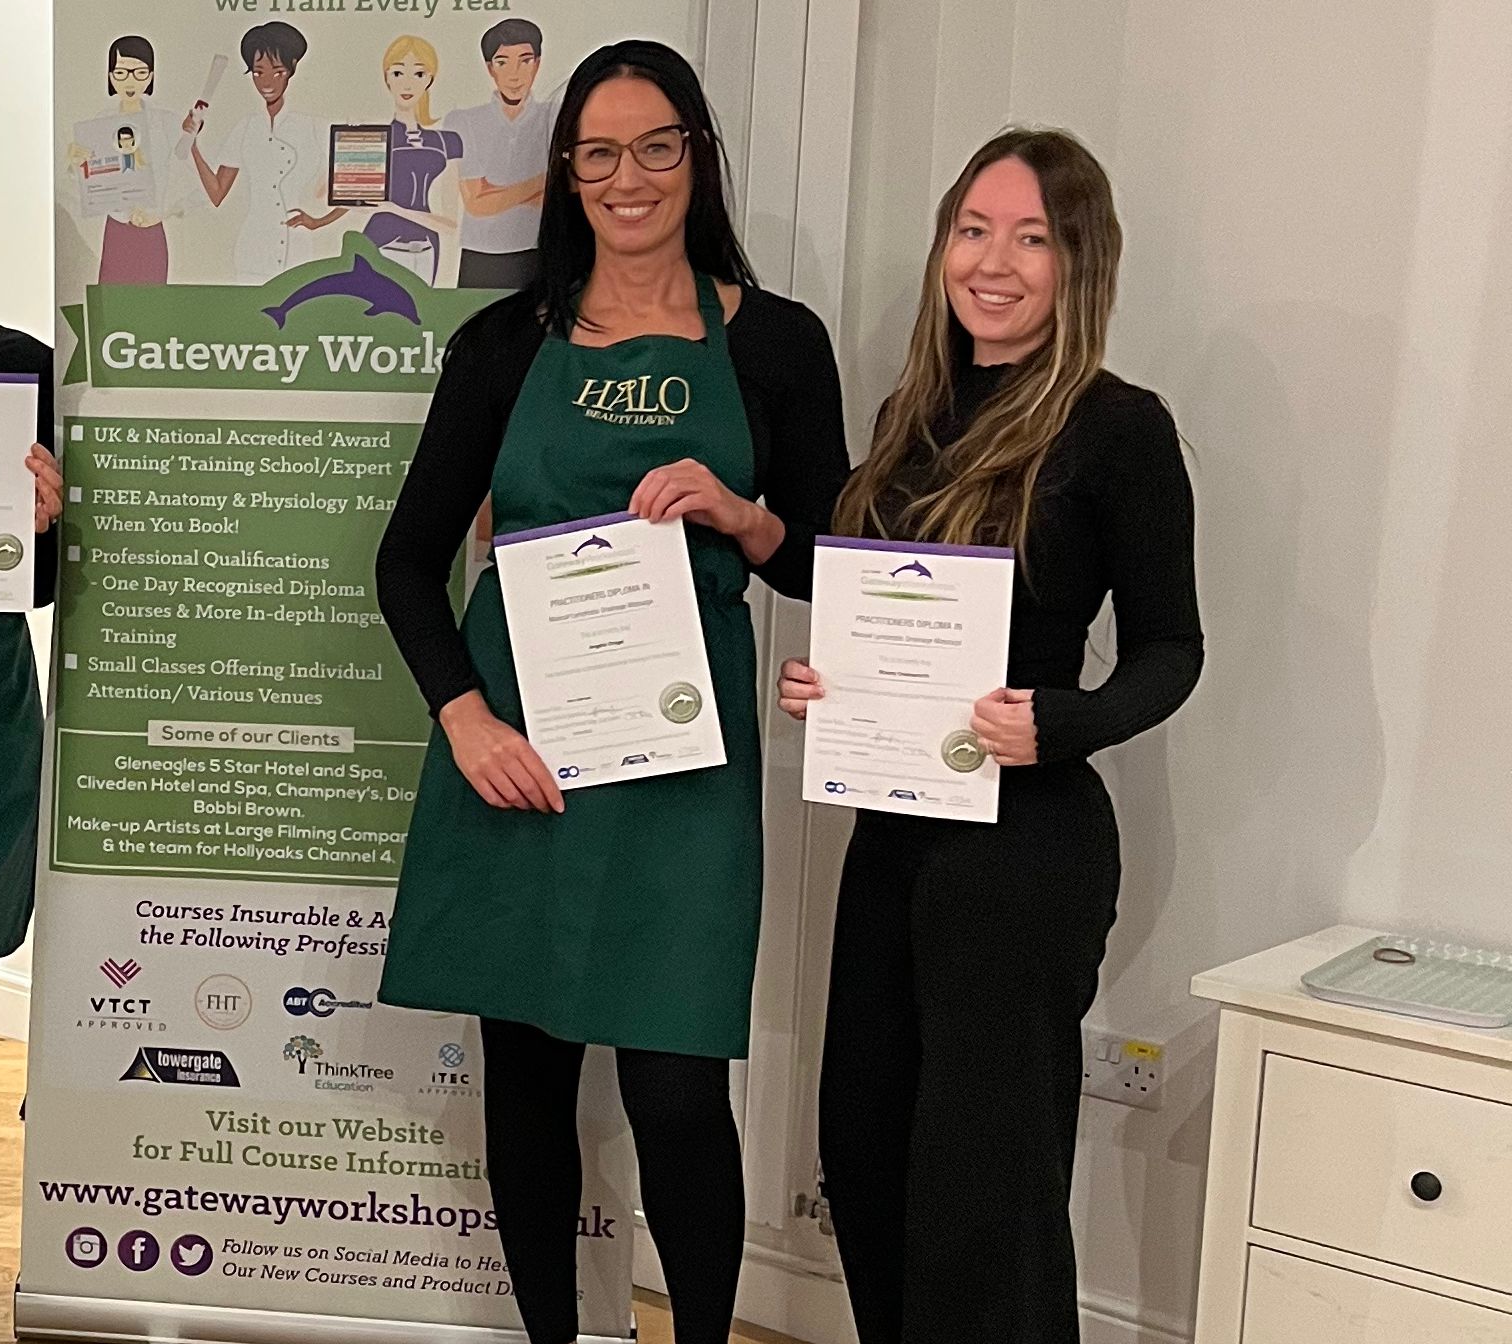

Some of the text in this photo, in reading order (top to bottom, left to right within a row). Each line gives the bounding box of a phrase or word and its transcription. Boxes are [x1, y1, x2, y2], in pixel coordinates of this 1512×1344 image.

[101, 331, 310, 384] Gateway
[571, 375, 690, 415] HALO
[94, 427, 123, 443] UK
[126, 427, 140, 443] &
[145, 427, 222, 445] National
[225, 428, 324, 447] Accredited
[178, 455, 256, 477] Training
[259, 455, 392, 479] School/Expert
[92, 489, 142, 506] FREE
[144, 490, 228, 512] Anatomy
[232, 492, 247, 508] &
[249, 491, 349, 514] Physiology
[92, 514, 240, 534] When You Book!
[91, 547, 330, 570] Professional Qualifications
[102, 575, 365, 600] One Day Recognised Diploma
[101, 601, 172, 618] Courses
[176, 603, 190, 619] &
[194, 603, 242, 620] More
[246, 604, 326, 626] In-depth
[100, 628, 177, 649] Training
[87, 655, 382, 682] Small Classes Offering Individual
[86, 682, 323, 705] Attention/ Various Venues
[161, 725, 340, 747] Some of our Clients
[114, 755, 387, 782] Gleneagles 5 Star Hotel and Spa,
[76, 774, 417, 803] Cliveden Hotel and Spa, Champney's, Dio
[193, 799, 305, 818] Bobbi Brown.
[67, 815, 141, 835] Make-up
[143, 819, 201, 835] Artists
[203, 822, 222, 836] at
[225, 821, 274, 842] Large
[277, 824, 337, 846] Filming
[102, 838, 395, 863] & the team for Hollyoaks Channel 4.
[136, 900, 224, 921] Courses
[229, 904, 340, 927] Insurable
[346, 910, 363, 928] &
[140, 924, 175, 945] the
[179, 927, 291, 956] Following
[90, 997, 152, 1014] VTCT
[76, 1020, 168, 1032] APPROVED
[157, 1050, 222, 1072] towergate
[314, 1061, 395, 1080] ThinkTree
[314, 1079, 374, 1093] Education
[205, 1110, 445, 1145] Visit our Website
[132, 1134, 488, 1180] for Full Course Informati
[221, 1238, 279, 1257] Follow
[283, 1246, 303, 1258] us
[307, 1248, 329, 1260] on
[333, 1246, 389, 1264] Social
[392, 1250, 449, 1268] Media
[455, 1255, 472, 1270] to
[222, 1262, 257, 1278] Our
[260, 1264, 301, 1281] New
[304, 1267, 378, 1287] Courses
[382, 1274, 417, 1290] and
[420, 1275, 491, 1295] Product
